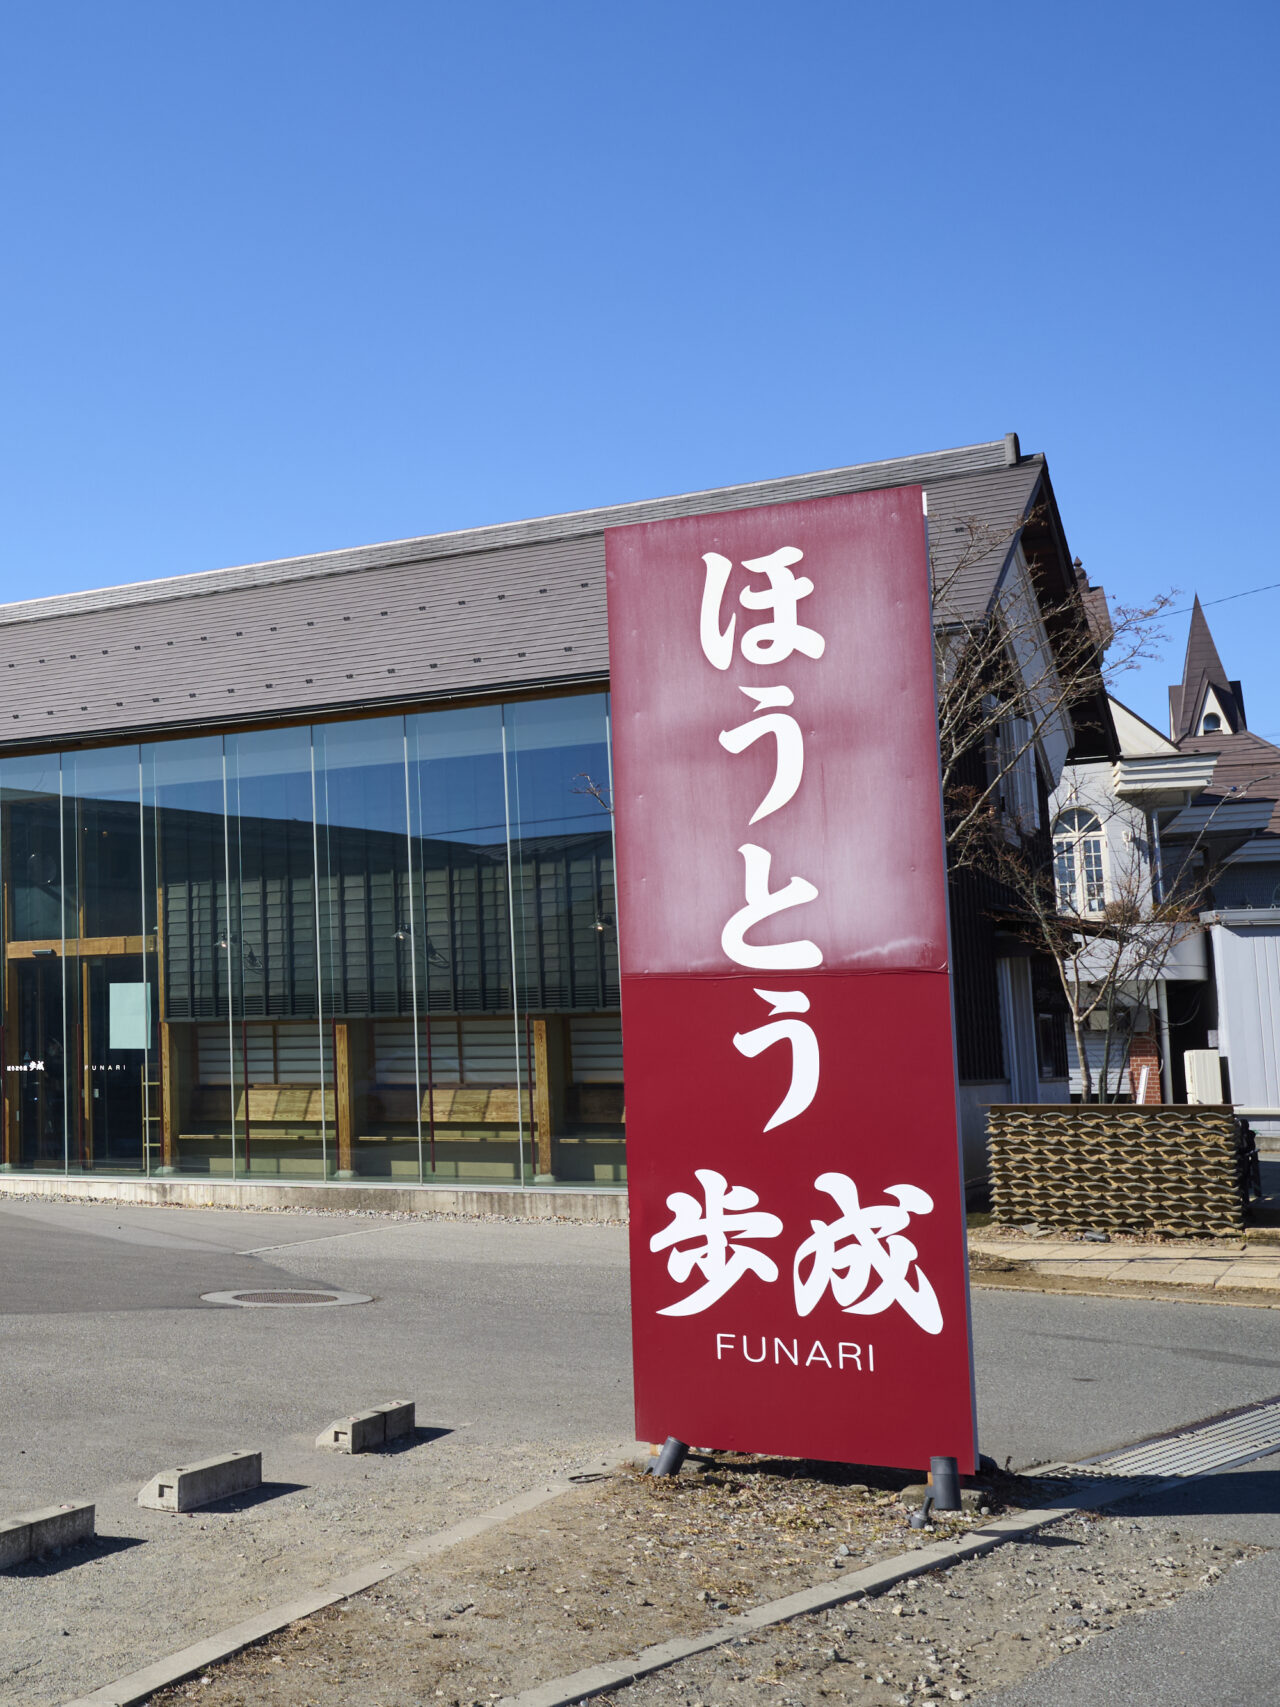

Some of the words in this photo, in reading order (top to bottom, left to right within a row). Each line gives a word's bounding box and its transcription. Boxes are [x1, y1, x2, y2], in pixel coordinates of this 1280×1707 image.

[700, 546, 825, 1133] ほうとう
[649, 1168, 944, 1335] 歩成
[716, 1333, 874, 1372] FUNARI
